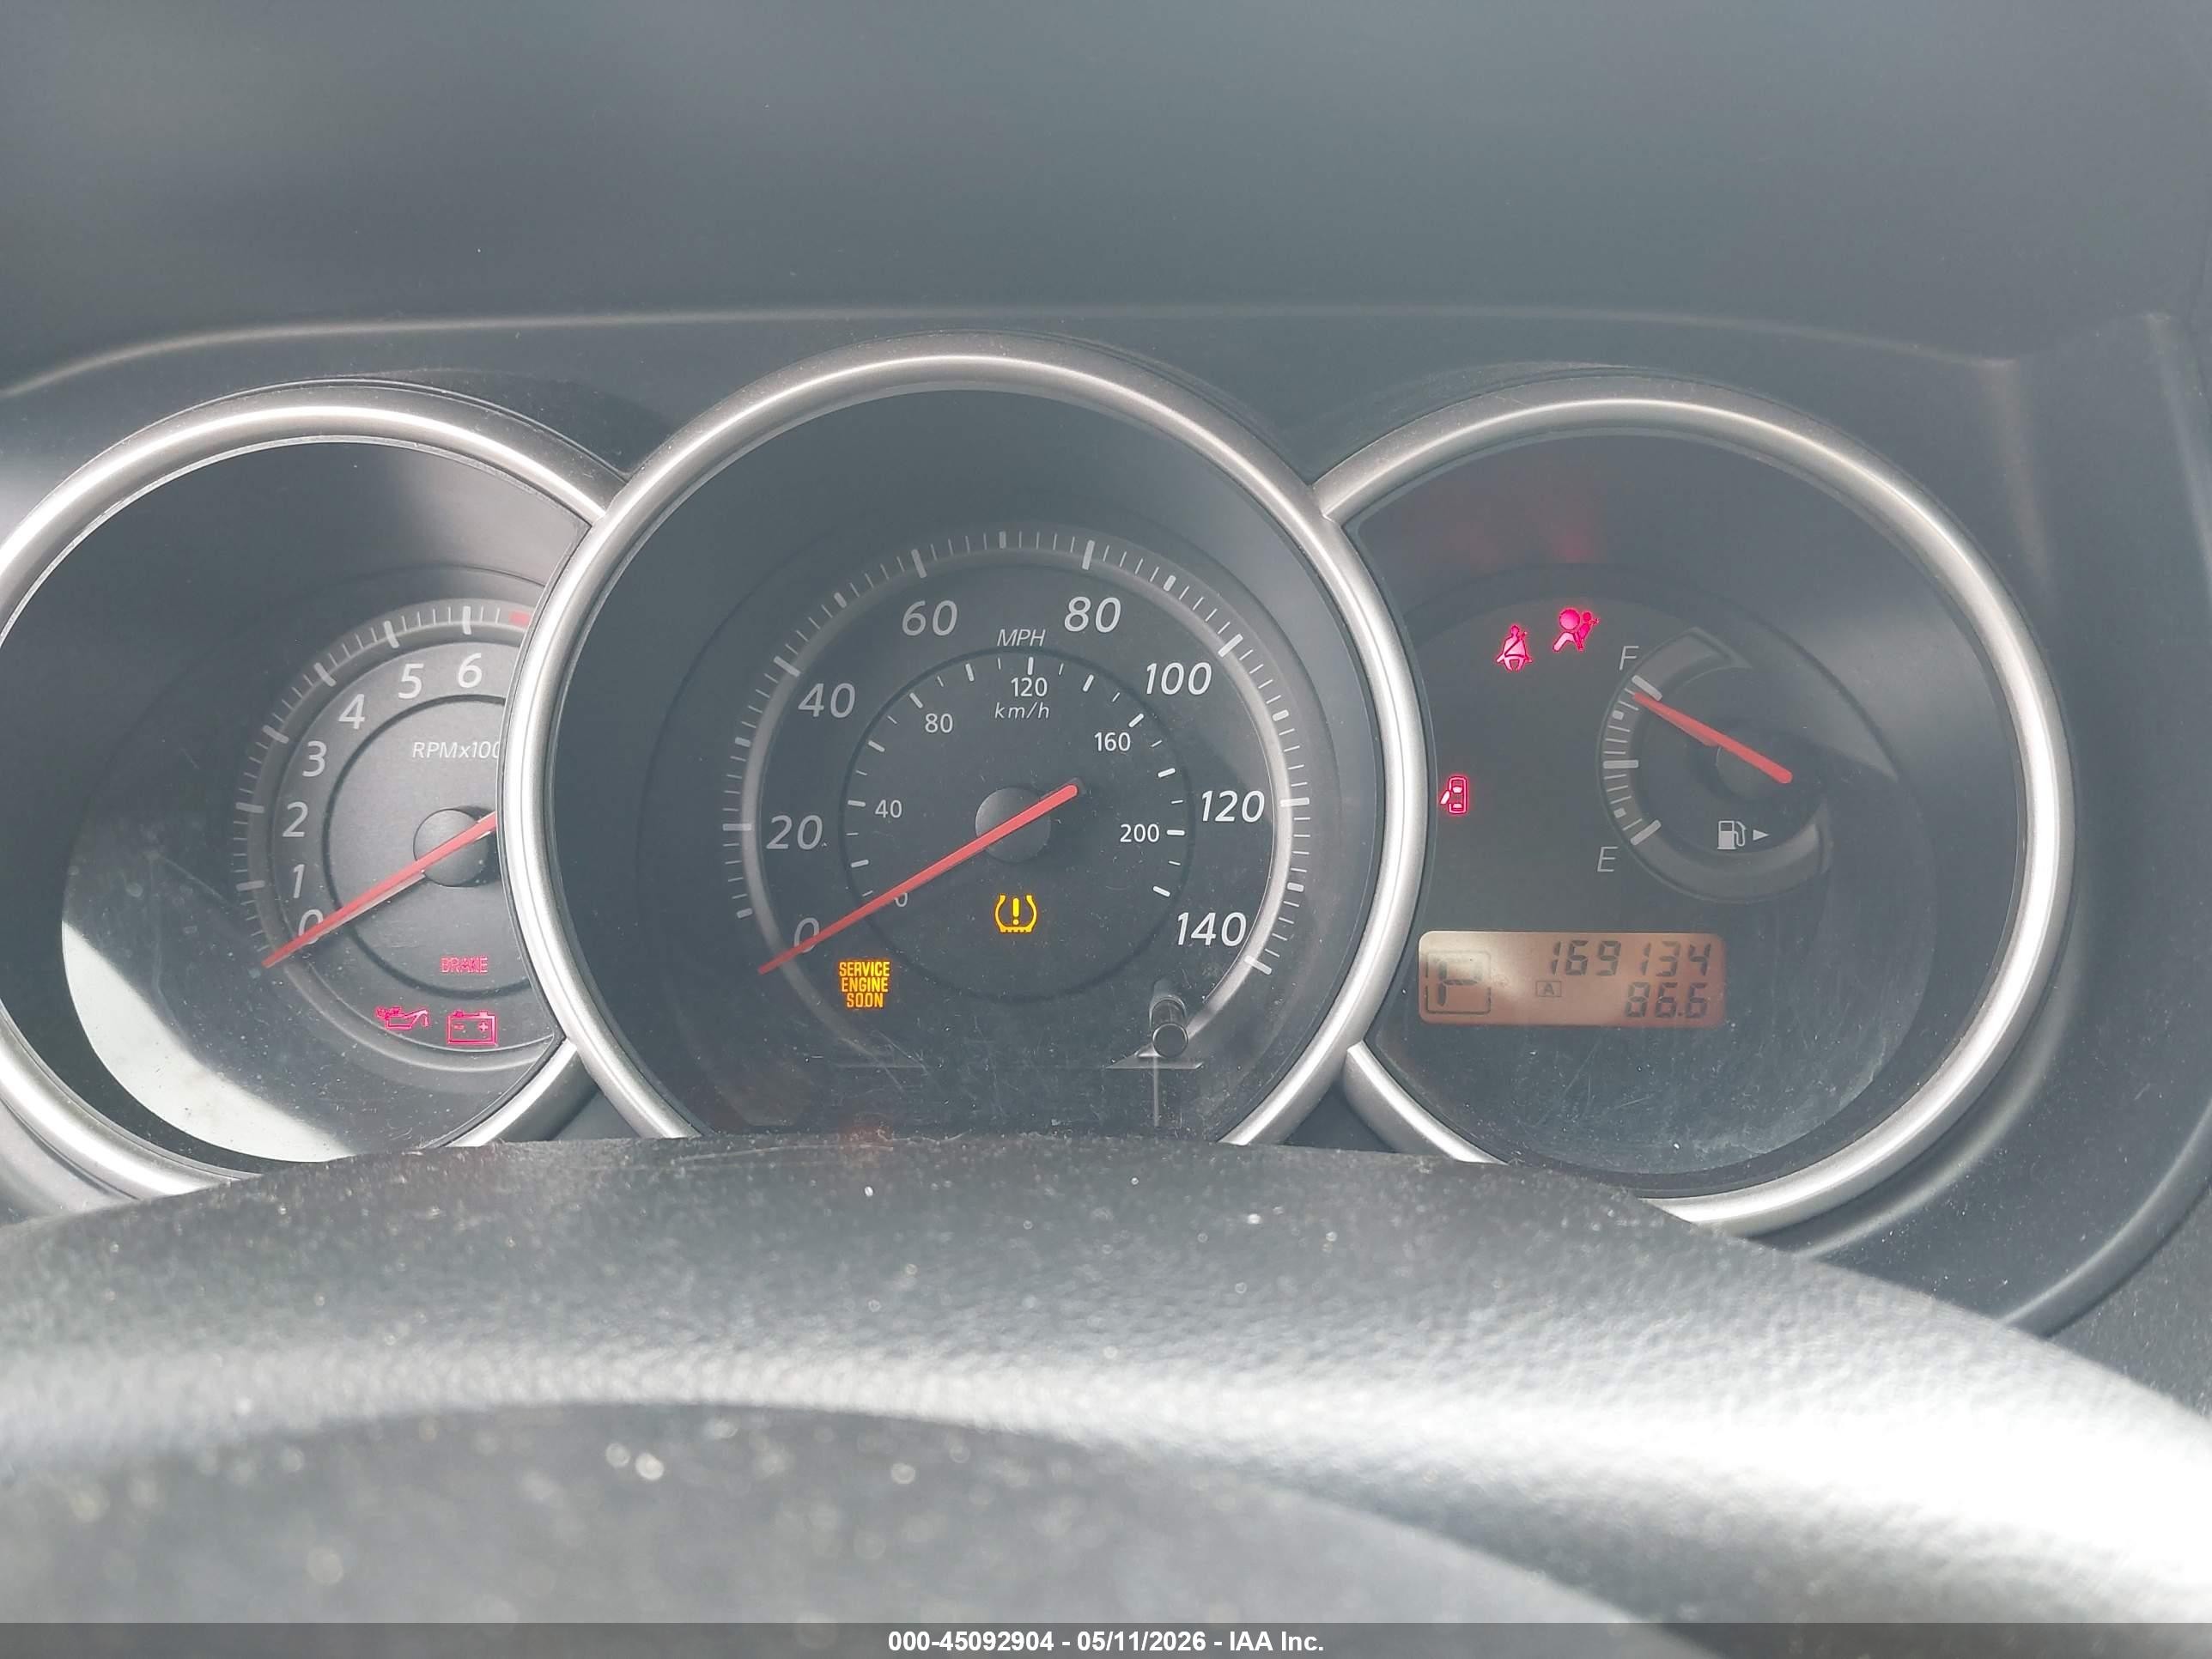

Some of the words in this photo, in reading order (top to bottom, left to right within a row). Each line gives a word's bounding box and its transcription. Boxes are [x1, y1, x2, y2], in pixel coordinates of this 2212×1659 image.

[902, 599, 958, 636] 60
[1063, 596, 1121, 633] 80
[997, 629, 1047, 647] MPH
[457, 653, 483, 688] 6
[1620, 645, 1639, 671] F
[398, 663, 425, 699] 5
[1010, 677, 1048, 697] 120
[1146, 662, 1212, 696] 100
[338, 694, 365, 730] 4
[797, 683, 856, 718] 40
[994, 702, 1050, 720] km/h
[924, 713, 953, 733] 80
[302, 740, 327, 777] 3
[1094, 732, 1131, 751] 160
[282, 801, 309, 837] 2
[874, 799, 902, 818] 40
[1201, 790, 1265, 823] 120
[766, 815, 823, 850] 20
[1119, 823, 1160, 842] 200
[1596, 846, 1618, 872] E
[293, 864, 306, 899] 1
[298, 908, 324, 945] 0
[793, 917, 820, 953] 0
[1176, 912, 1247, 947] 140
[441, 957, 489, 974] BRAKE
[839, 961, 890, 977] SERVICE
[1550, 939, 1712, 977] 169134
[842, 977, 889, 993] ENGINE
[847, 993, 884, 1008] SOON
[1626, 981, 1709, 1018] 86.6
